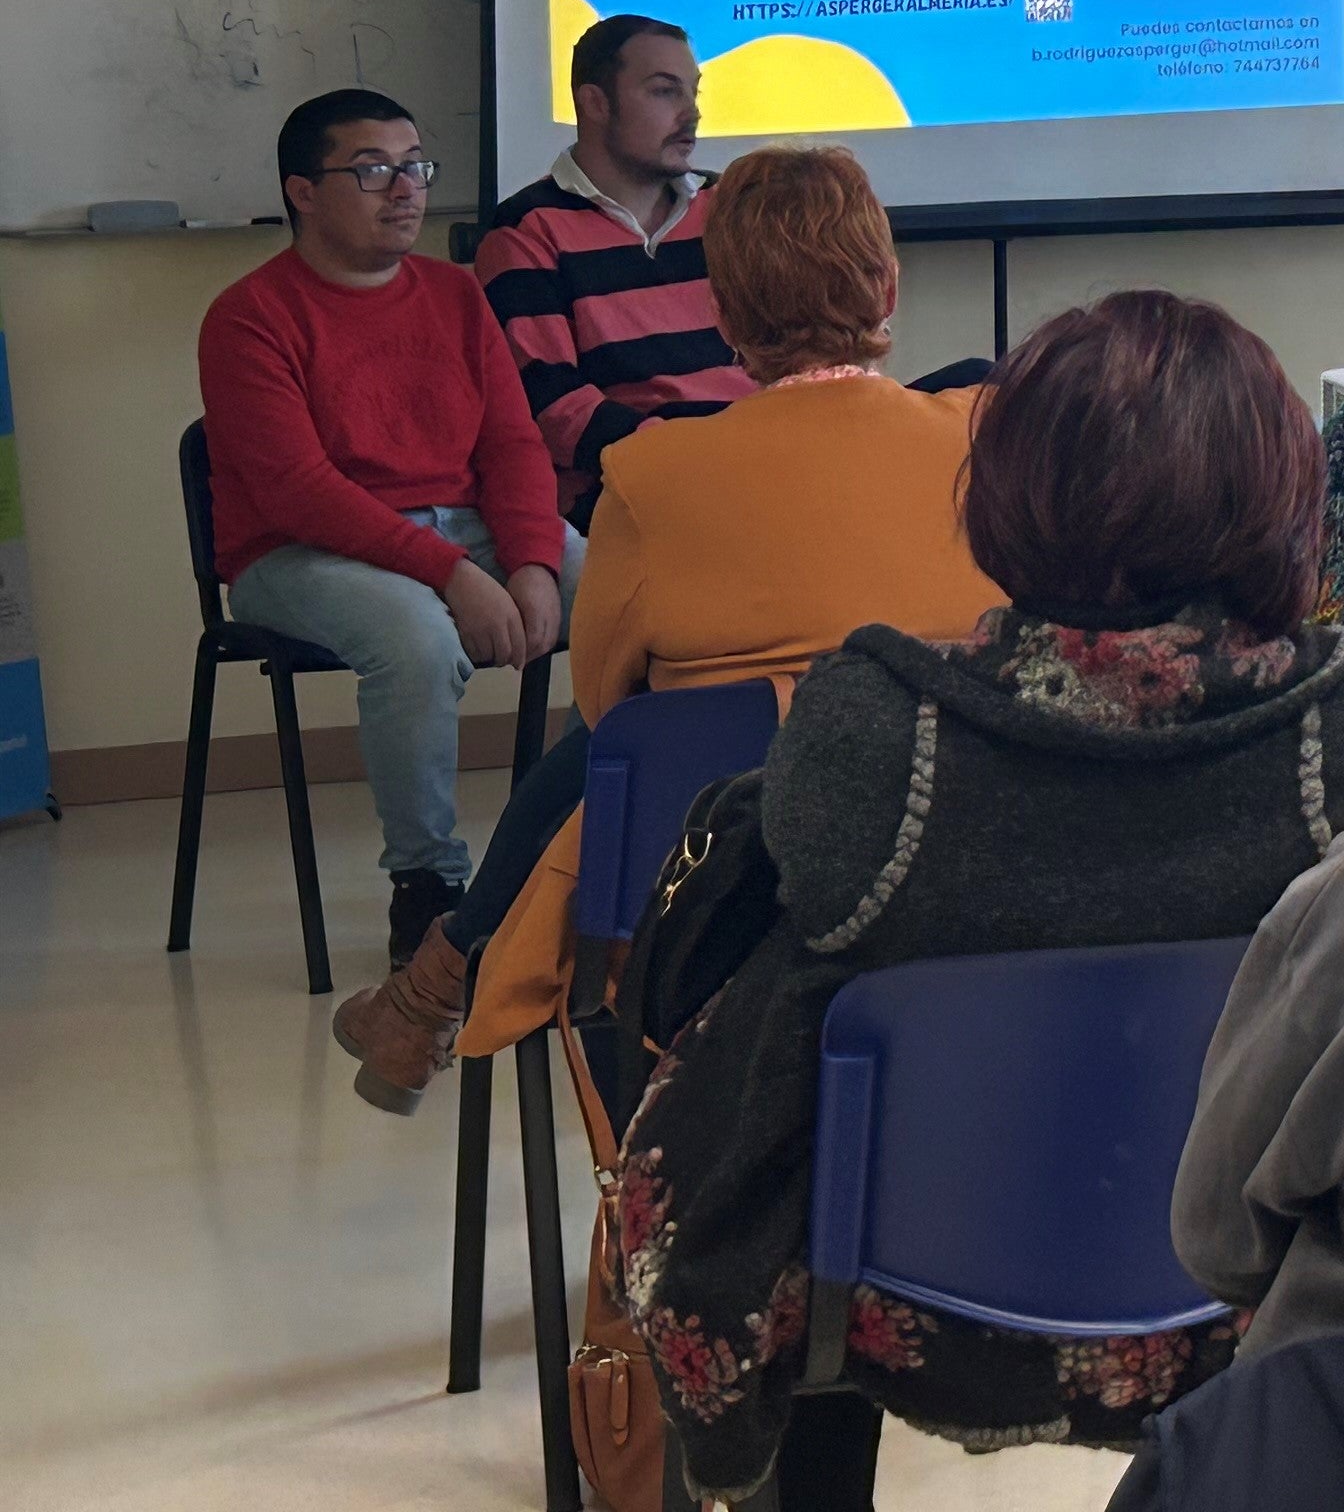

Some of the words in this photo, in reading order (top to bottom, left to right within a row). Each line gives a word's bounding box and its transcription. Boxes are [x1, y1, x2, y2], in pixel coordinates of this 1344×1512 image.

[1120, 21, 1180, 37] Puedes
[1185, 16, 1294, 34] contactarnos
[1299, 16, 1320, 29] en
